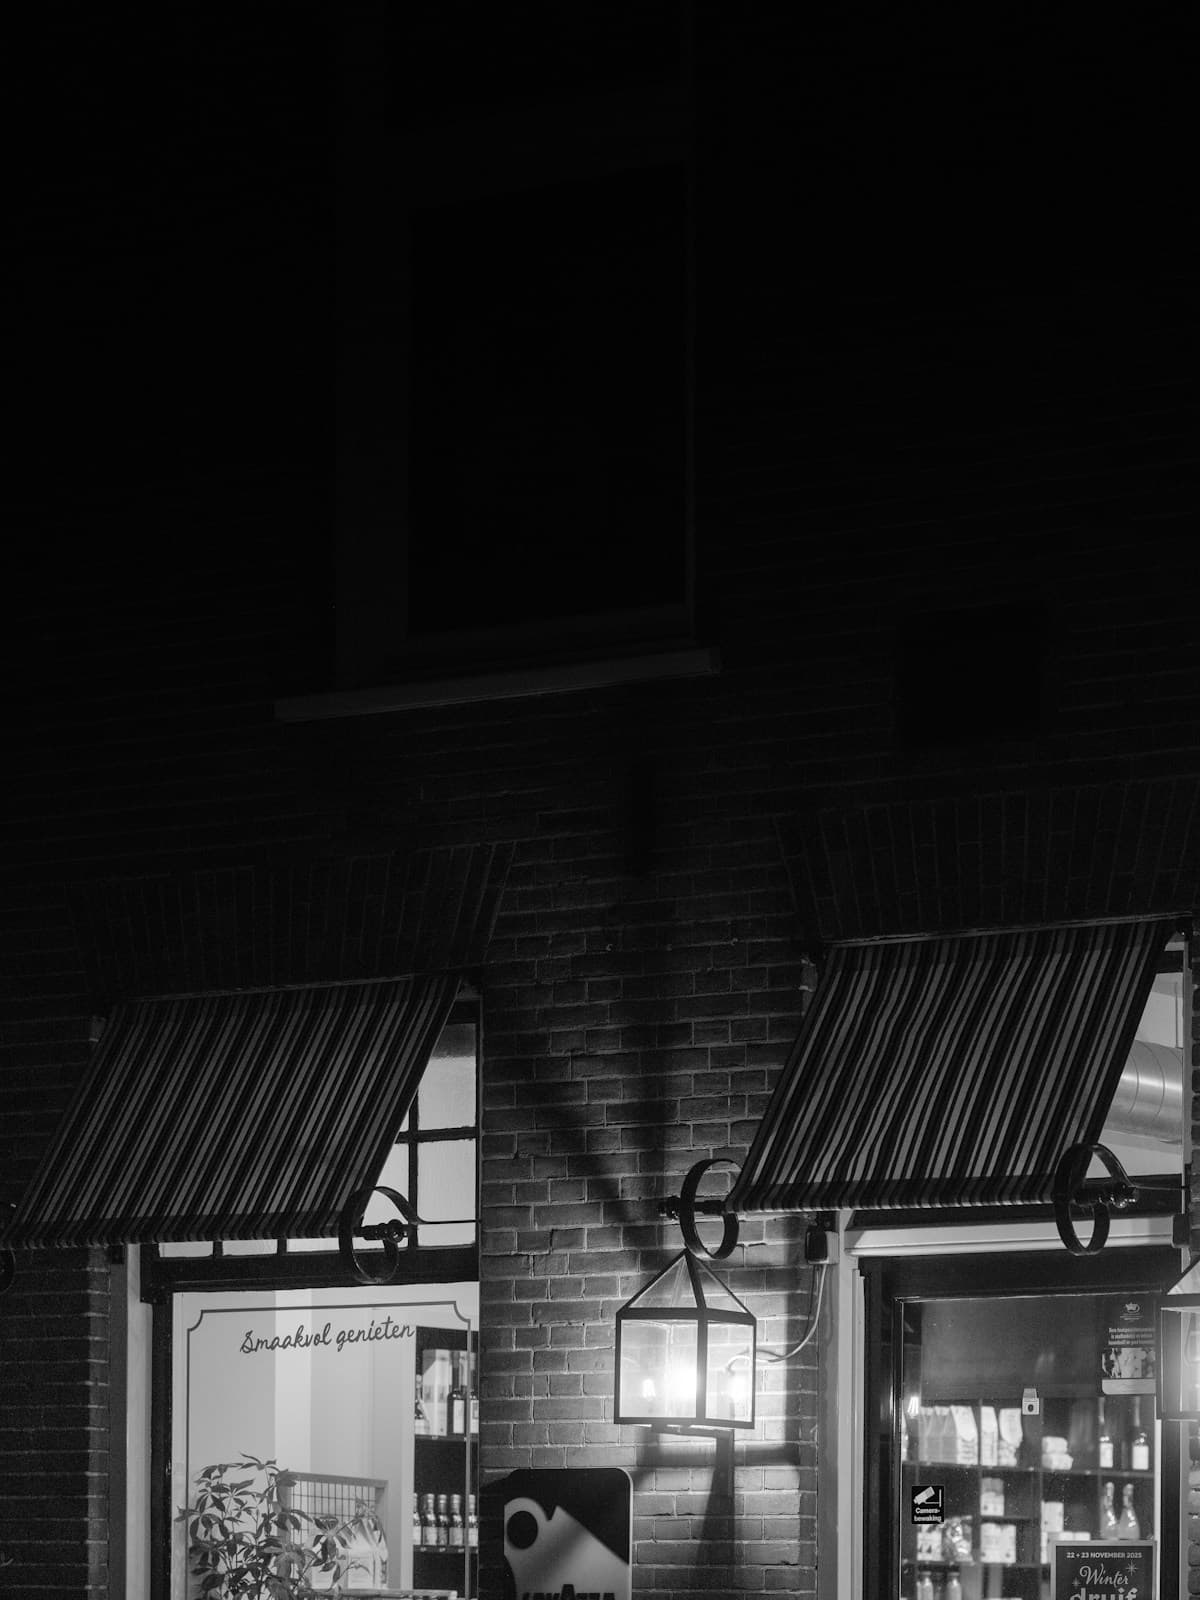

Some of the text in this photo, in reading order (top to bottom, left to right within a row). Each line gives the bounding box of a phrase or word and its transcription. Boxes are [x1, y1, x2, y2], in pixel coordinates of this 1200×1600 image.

[240, 1316, 415, 1353] Smaakvol genieten
[1090, 1551, 1125, 1559] NOVEMBER
[1079, 1562, 1129, 1588] Winter
